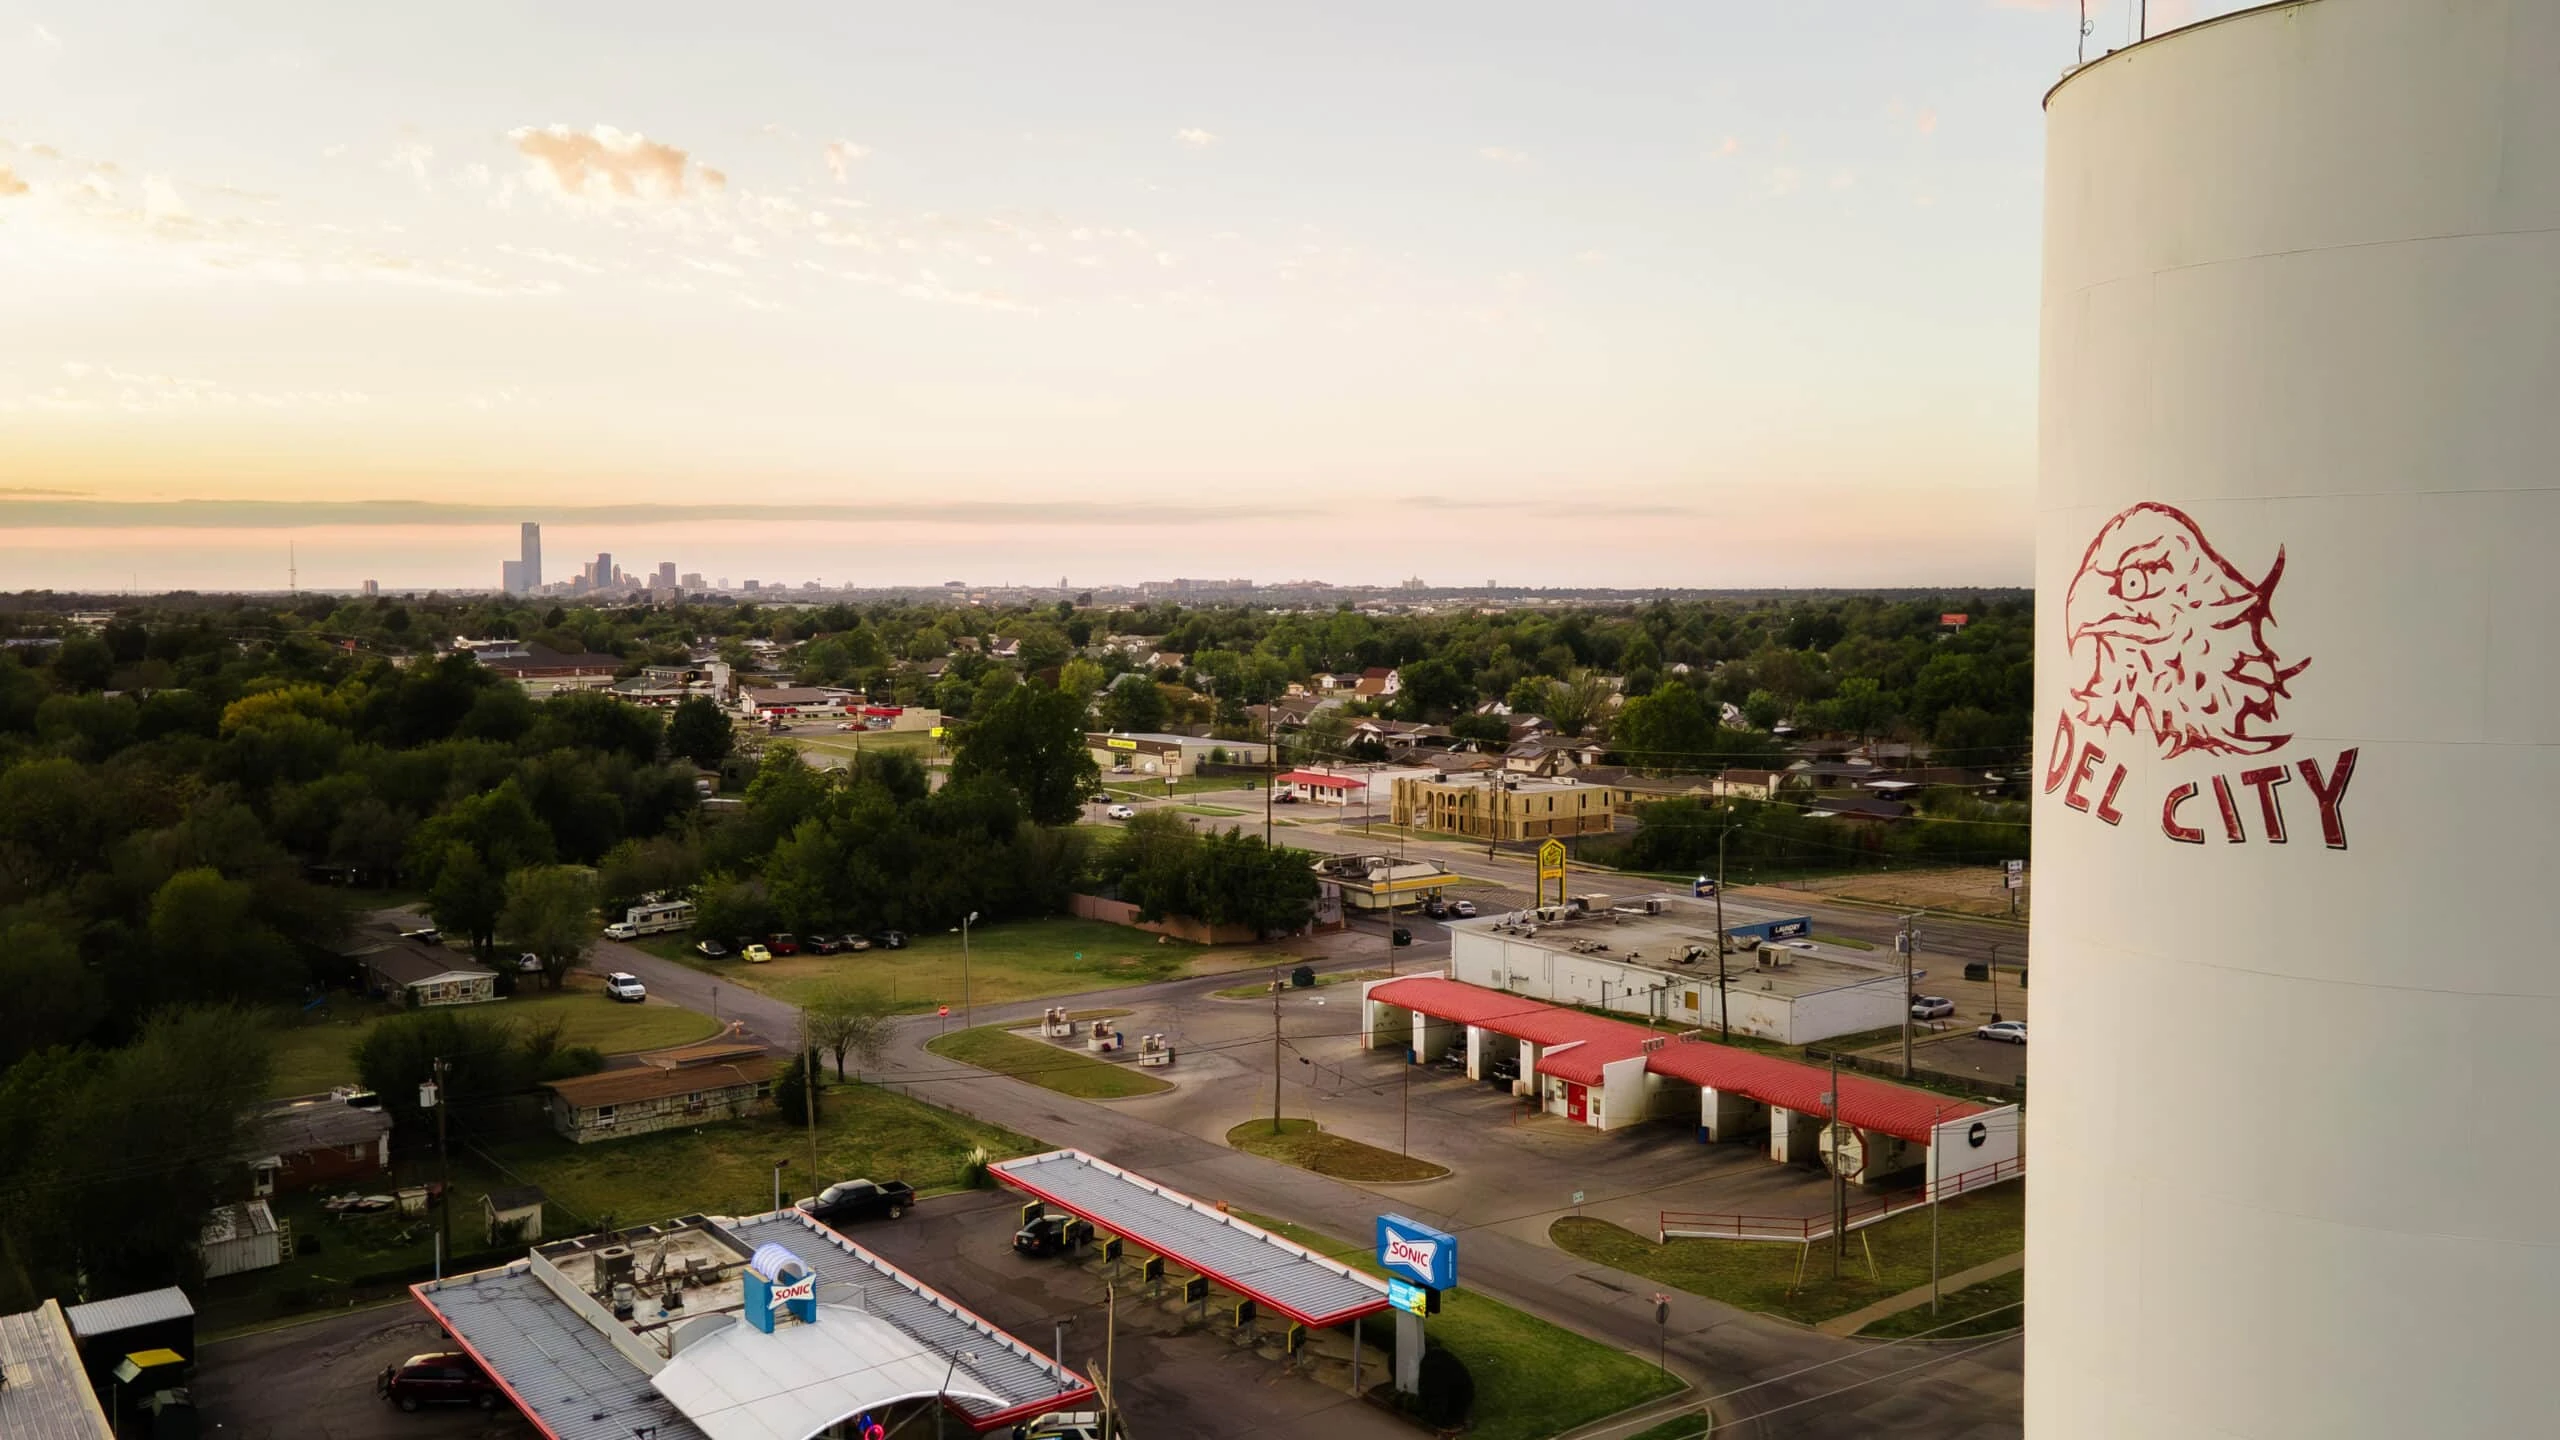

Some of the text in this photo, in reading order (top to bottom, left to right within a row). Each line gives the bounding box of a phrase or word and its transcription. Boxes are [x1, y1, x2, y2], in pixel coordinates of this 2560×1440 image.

[2044, 709, 2359, 850] DEL CITY
[1391, 1241, 1429, 1267] SONIC
[775, 1283, 810, 1301] SONIC
